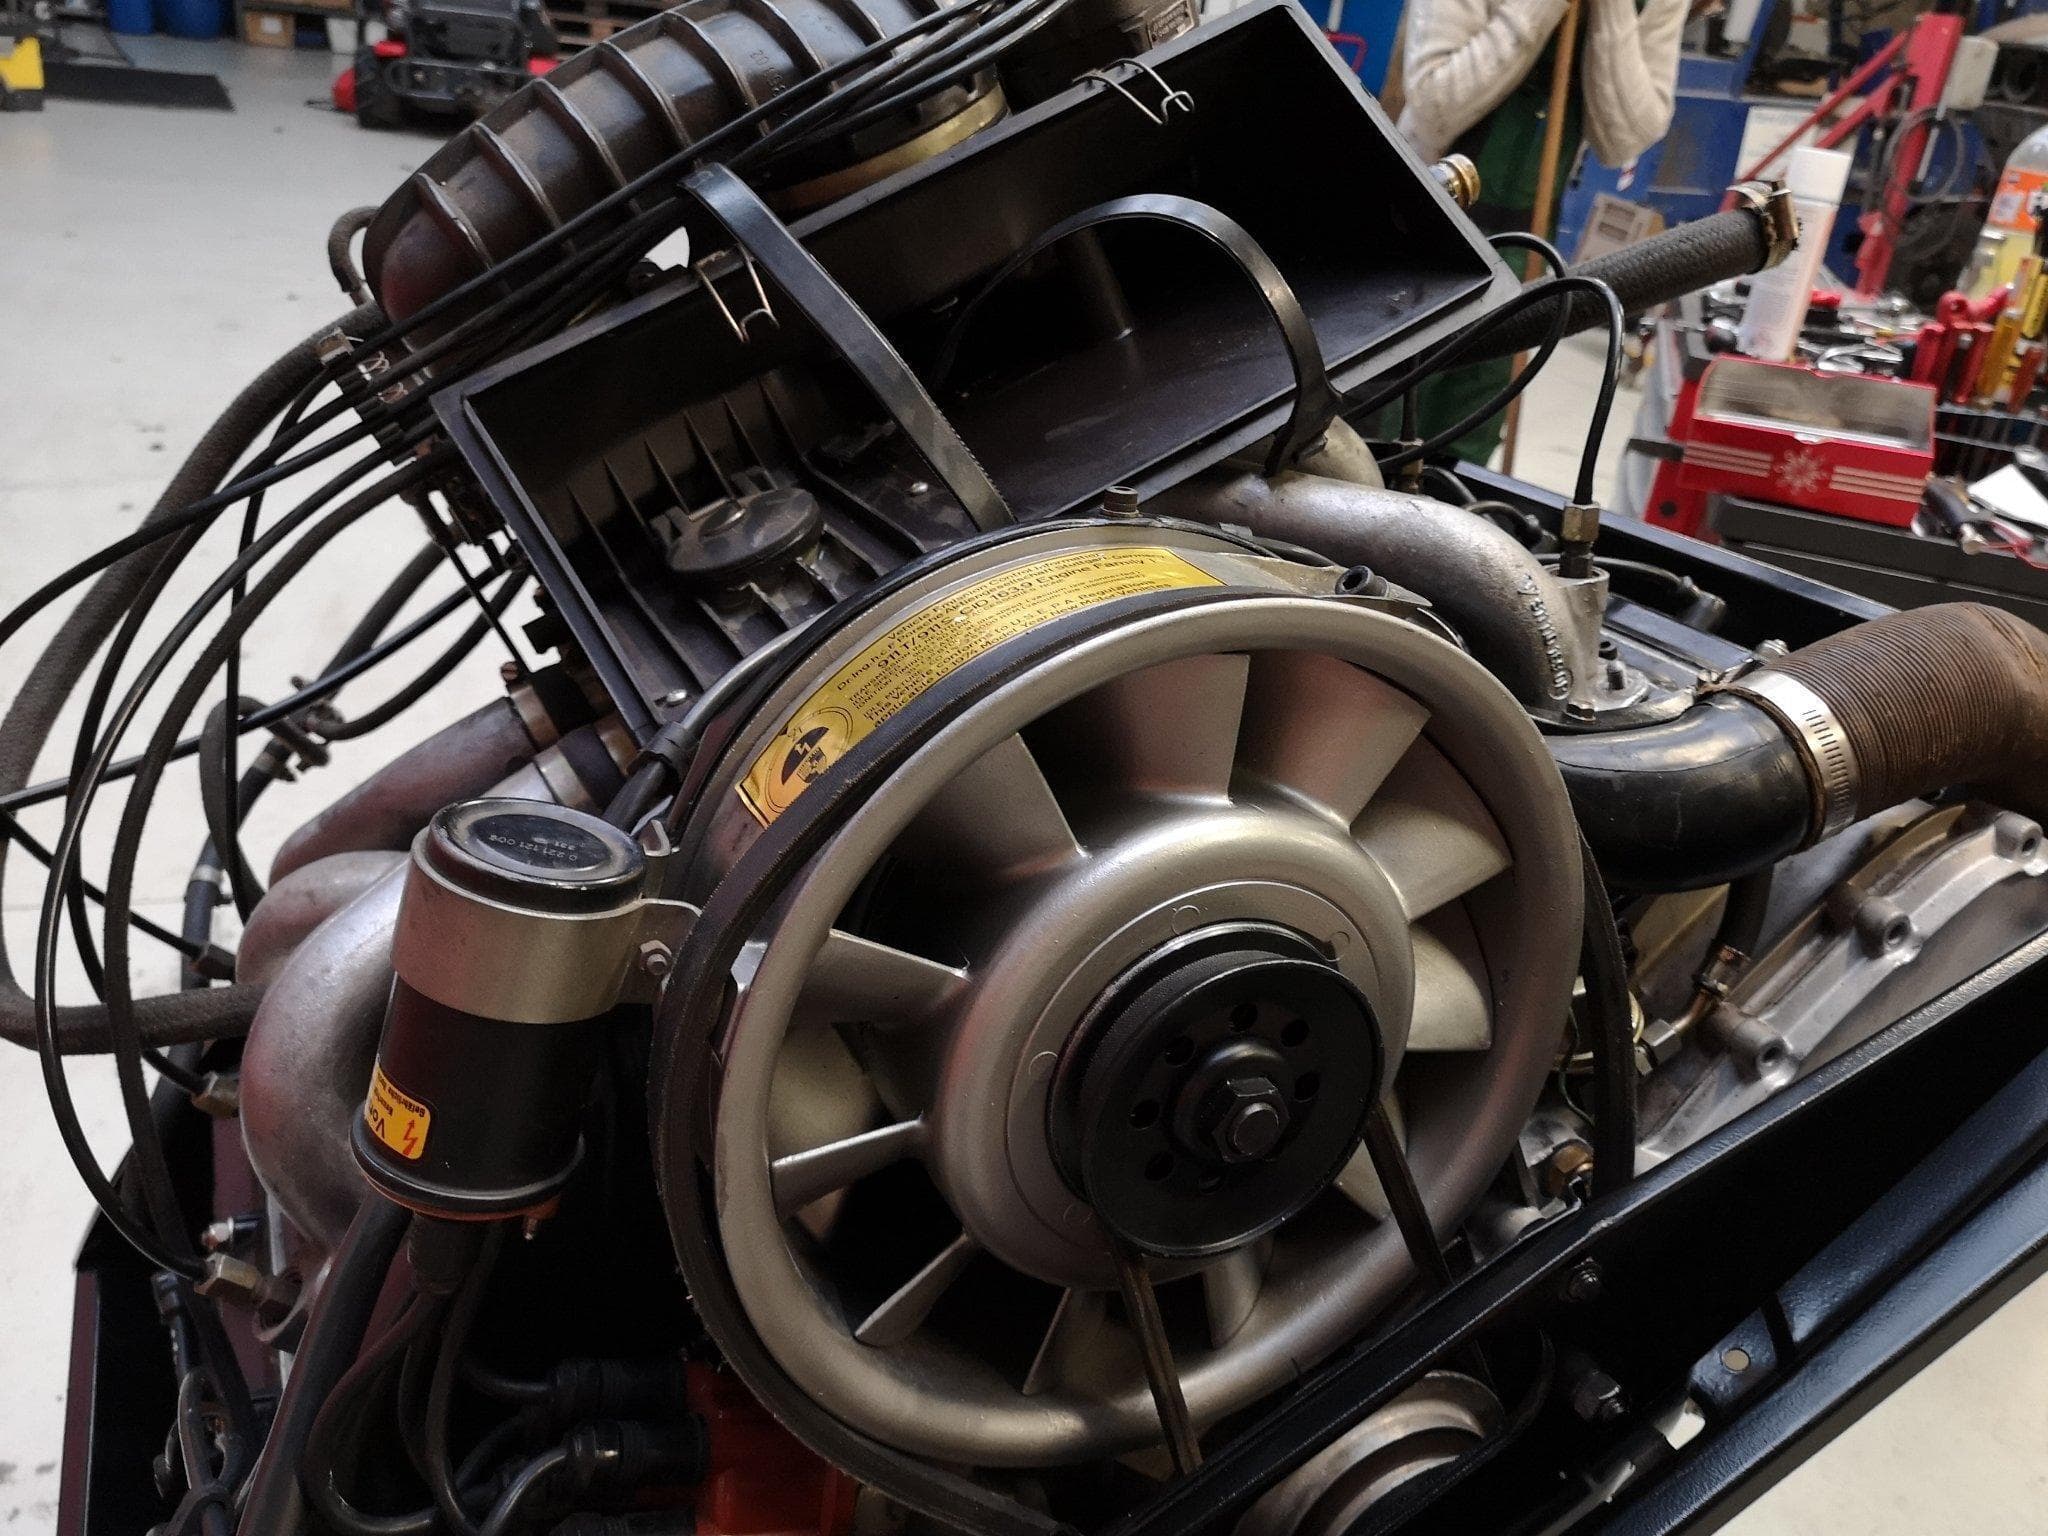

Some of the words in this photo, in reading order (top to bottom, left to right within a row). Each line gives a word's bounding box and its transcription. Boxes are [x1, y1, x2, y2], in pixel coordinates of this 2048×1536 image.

[875, 648, 901, 670] 911
[957, 597, 990, 616] CID
[989, 580, 1035, 601] 163.9
[1034, 564, 1093, 585] Engine
[1091, 558, 1147, 570] Family
[886, 611, 931, 641] Vehicle
[993, 623, 1009, 633] to
[934, 665, 950, 677] to
[978, 627, 1019, 649] Model
